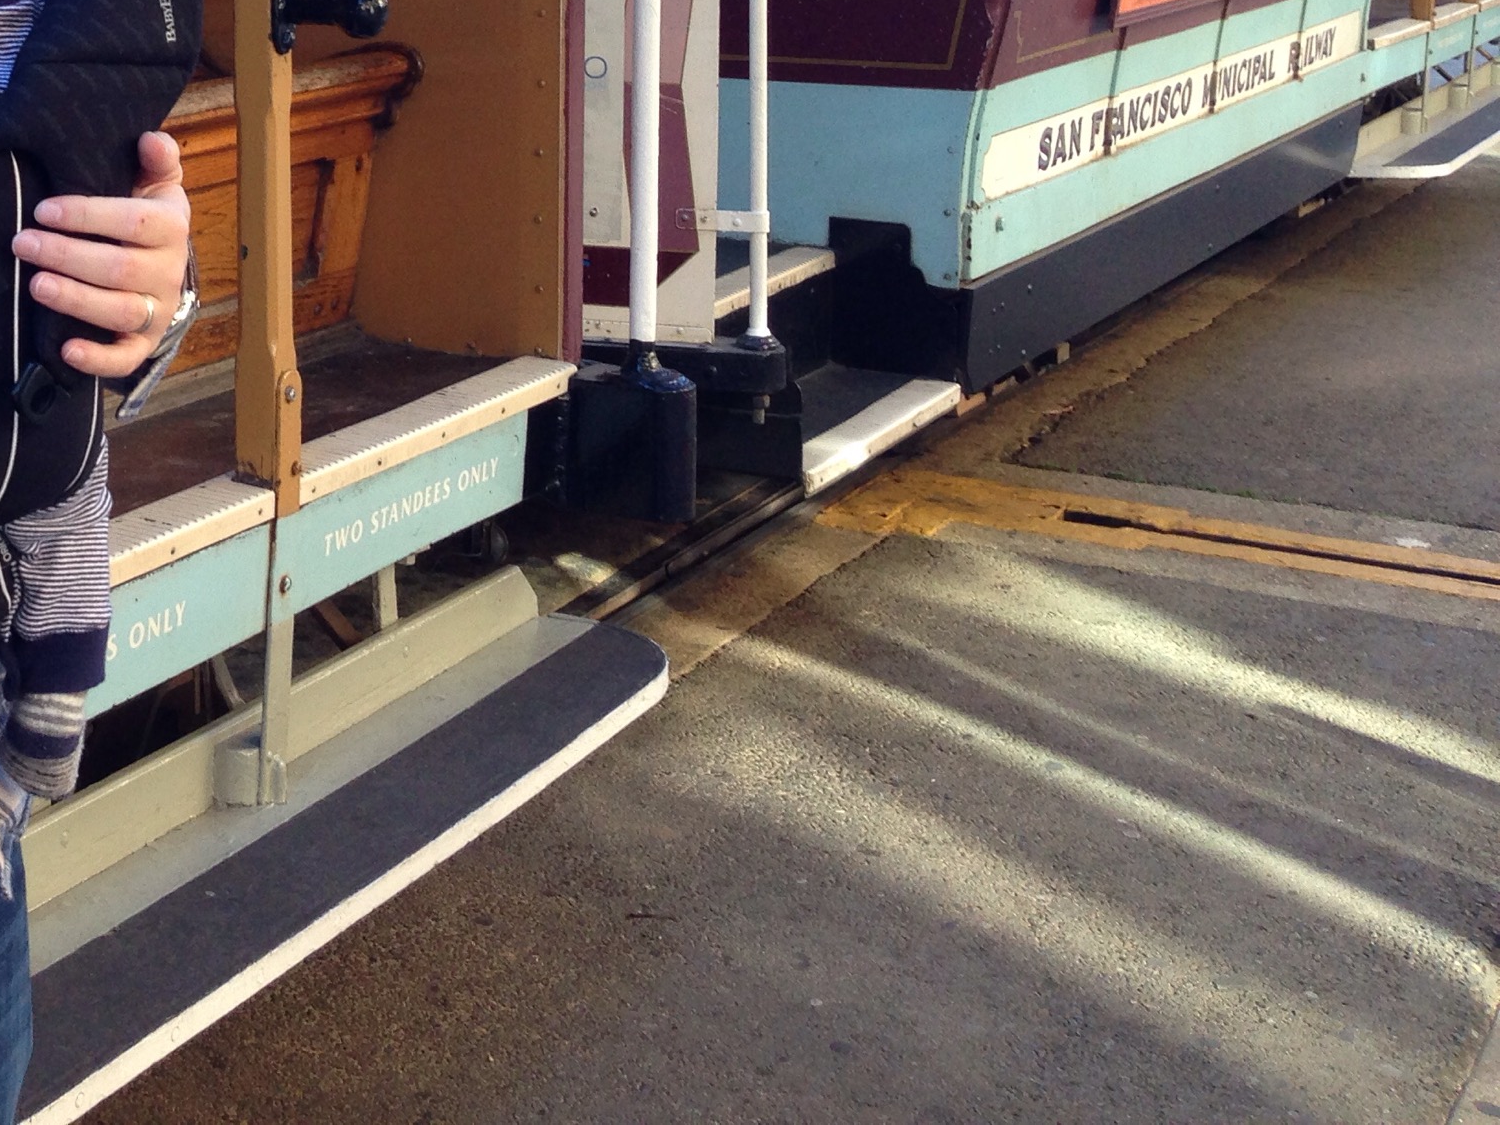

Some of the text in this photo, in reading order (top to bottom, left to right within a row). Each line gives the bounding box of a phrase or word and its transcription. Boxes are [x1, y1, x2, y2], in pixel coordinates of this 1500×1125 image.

[1037, 116, 1083, 172] SAN
[1089, 77, 1193, 152] FRANCISCO
[1287, 26, 1337, 75] RILWAY
[324, 457, 499, 557] TWO STANDEES ONLY
[129, 599, 186, 649] ONLY
